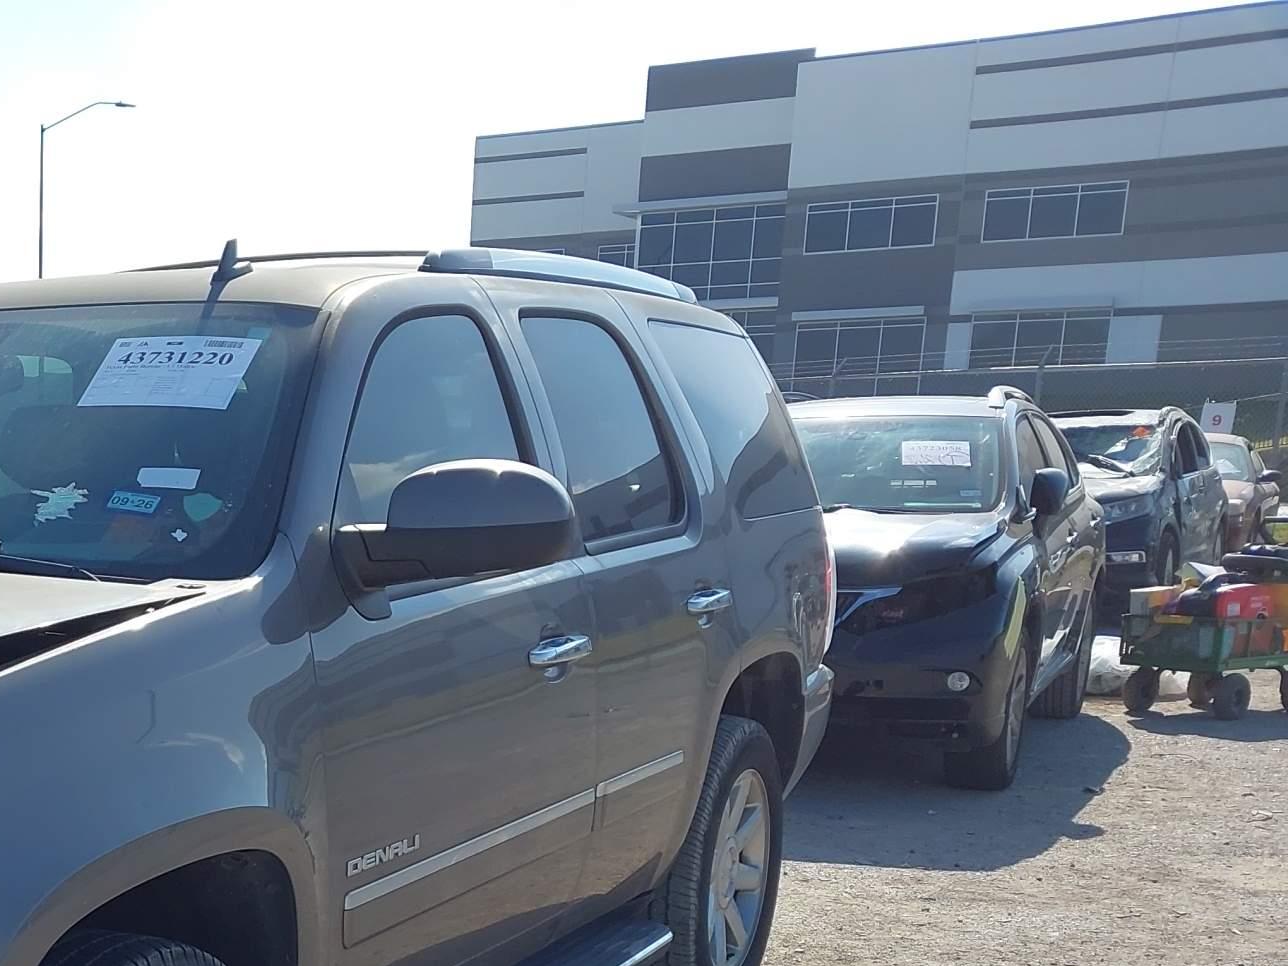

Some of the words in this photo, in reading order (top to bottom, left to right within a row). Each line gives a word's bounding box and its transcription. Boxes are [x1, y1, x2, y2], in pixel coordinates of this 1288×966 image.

[117, 352, 234, 365] 43731220
[1212, 415, 1222, 426] 9
[112, 495, 130, 506] 09
[134, 499, 154, 509] 26
[346, 833, 420, 877] DENALI
